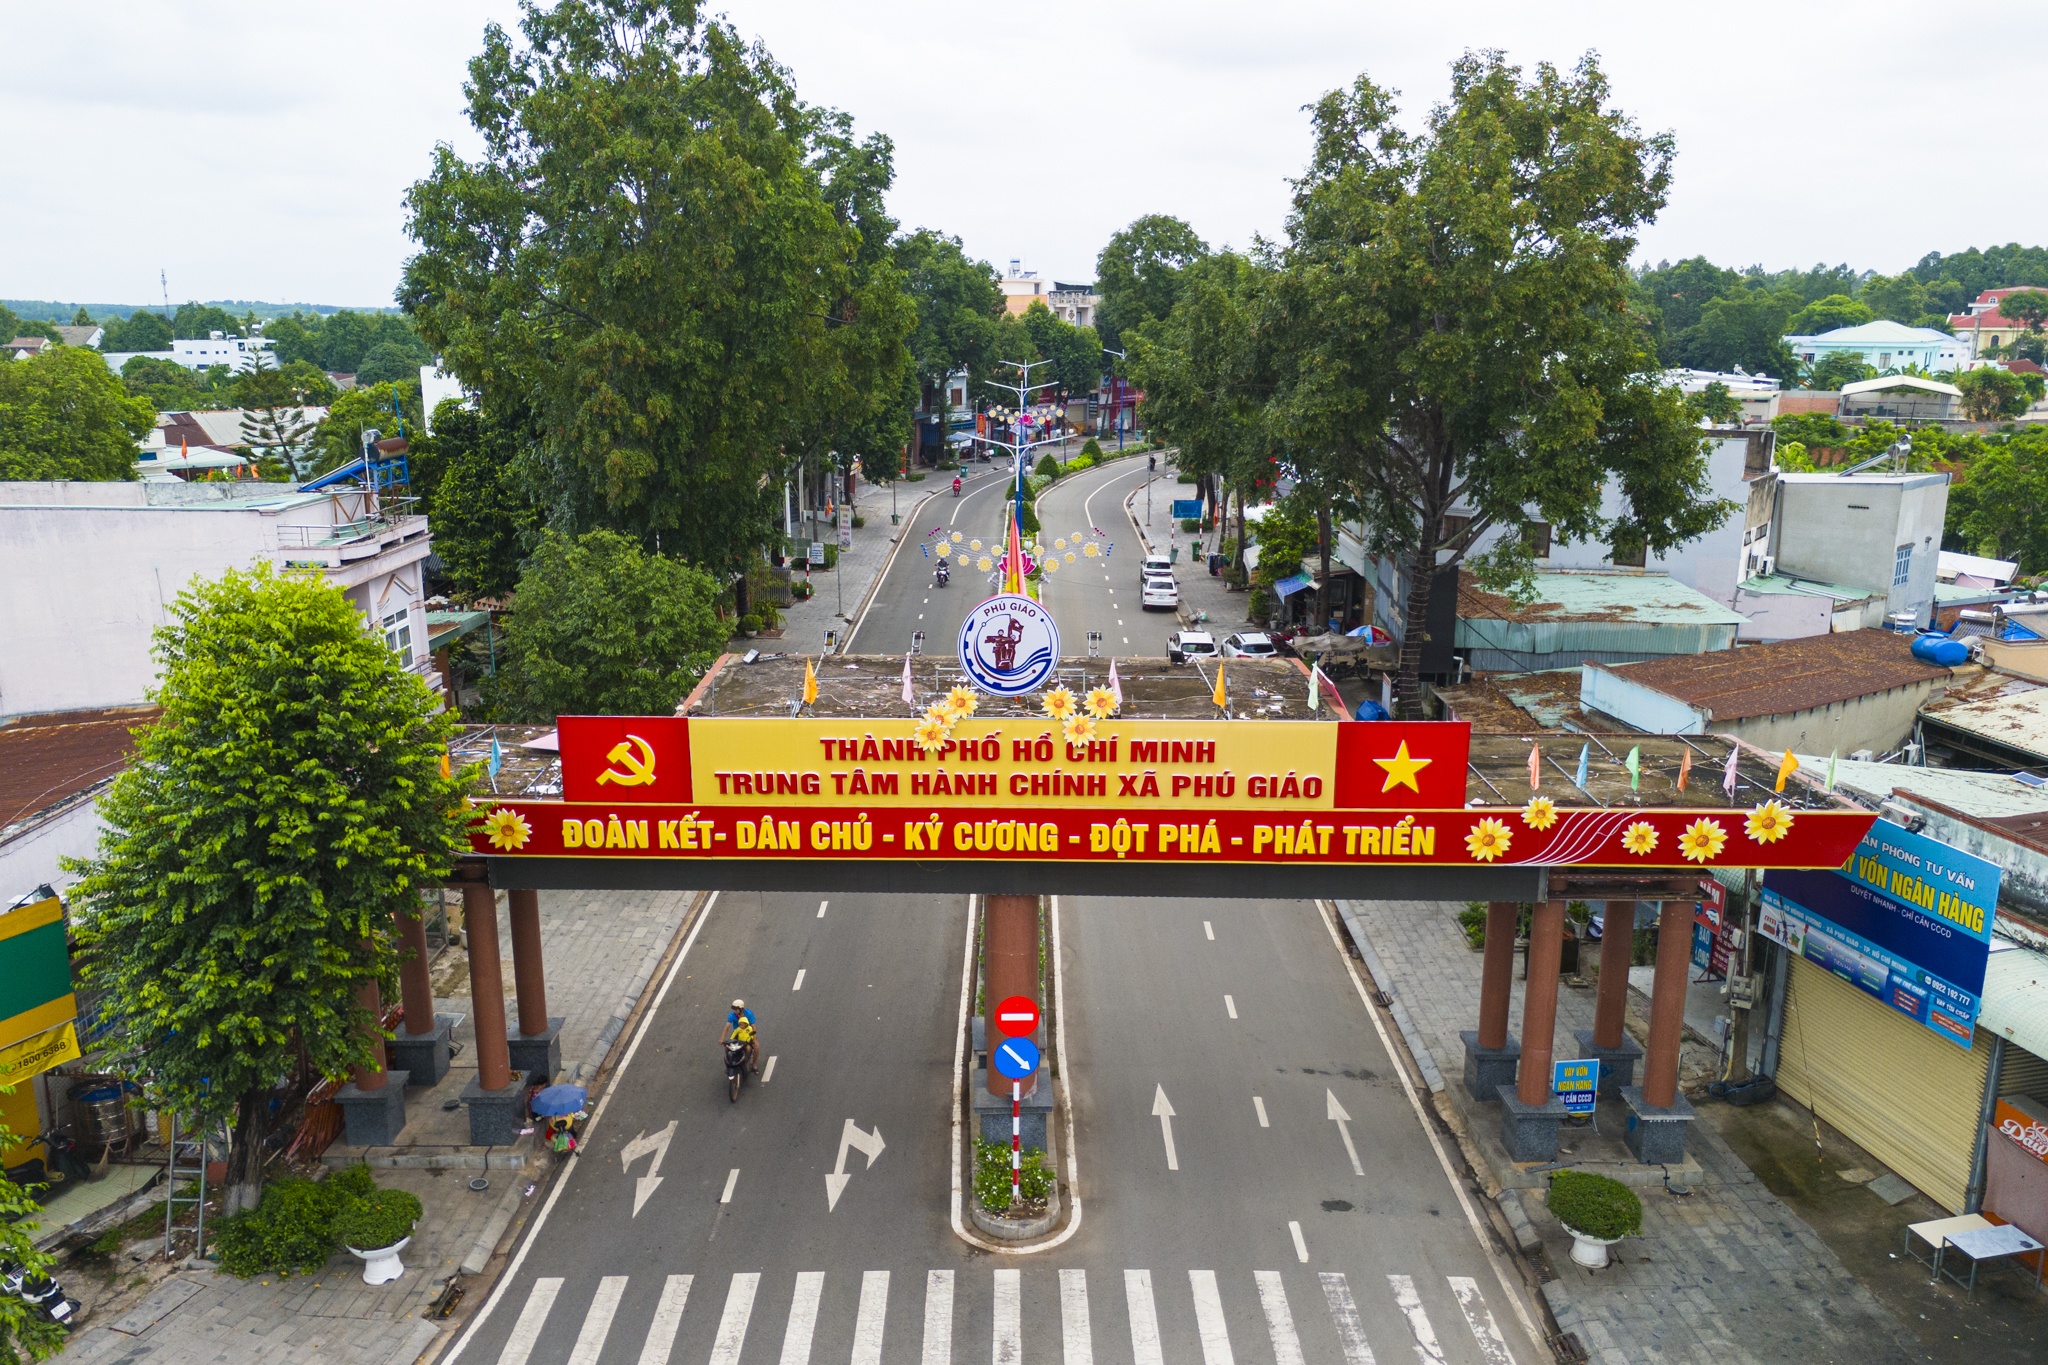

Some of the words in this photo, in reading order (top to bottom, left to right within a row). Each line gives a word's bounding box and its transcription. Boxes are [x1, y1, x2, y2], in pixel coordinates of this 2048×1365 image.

[983, 600, 1006, 617] PHÚ
[1010, 602, 1036, 618] GIÁO
[820, 732, 926, 762] THÀNH
[937, 730, 1002, 762] PHỐ
[1012, 730, 1053, 762] HỒ
[1065, 734, 1119, 763] CHÍ
[1130, 739, 1216, 763] MINH
[714, 771, 820, 795] TRUNG
[831, 767, 899, 795] TÂM
[911, 767, 997, 796] HÀNH
[1009, 768, 1106, 796] CHÍNH
[1117, 769, 1160, 797] XÃ
[1171, 769, 1235, 798] PHÚ
[1247, 770, 1323, 799] GIÁO
[562, 813, 649, 849] ĐOÀN
[736, 815, 800, 850] DÂN
[810, 812, 873, 851] CHỦ
[904, 812, 944, 851] KỶ
[953, 819, 1059, 852] CƯƠNG
[1089, 817, 1149, 859] ĐỘT
[1158, 818, 1222, 854] PHÁ
[1253, 820, 1335, 855] PHÁT
[1342, 814, 1435, 856] TRIỂN
[1882, 842, 1921, 868] PHÒNG
[1925, 860, 1944, 876] TƯ
[1947, 869, 1975, 891] VẤN
[1858, 854, 1889, 890] VỐN
[1890, 871, 1936, 911] NGÂN
[1937, 891, 1985, 934] HÀNG
[1872, 895, 1897, 913] NHANH
[1930, 922, 1952, 938] CCCD
[1958, 993, 1971, 1006] 777
[17, 1053, 41, 1068] 1800
